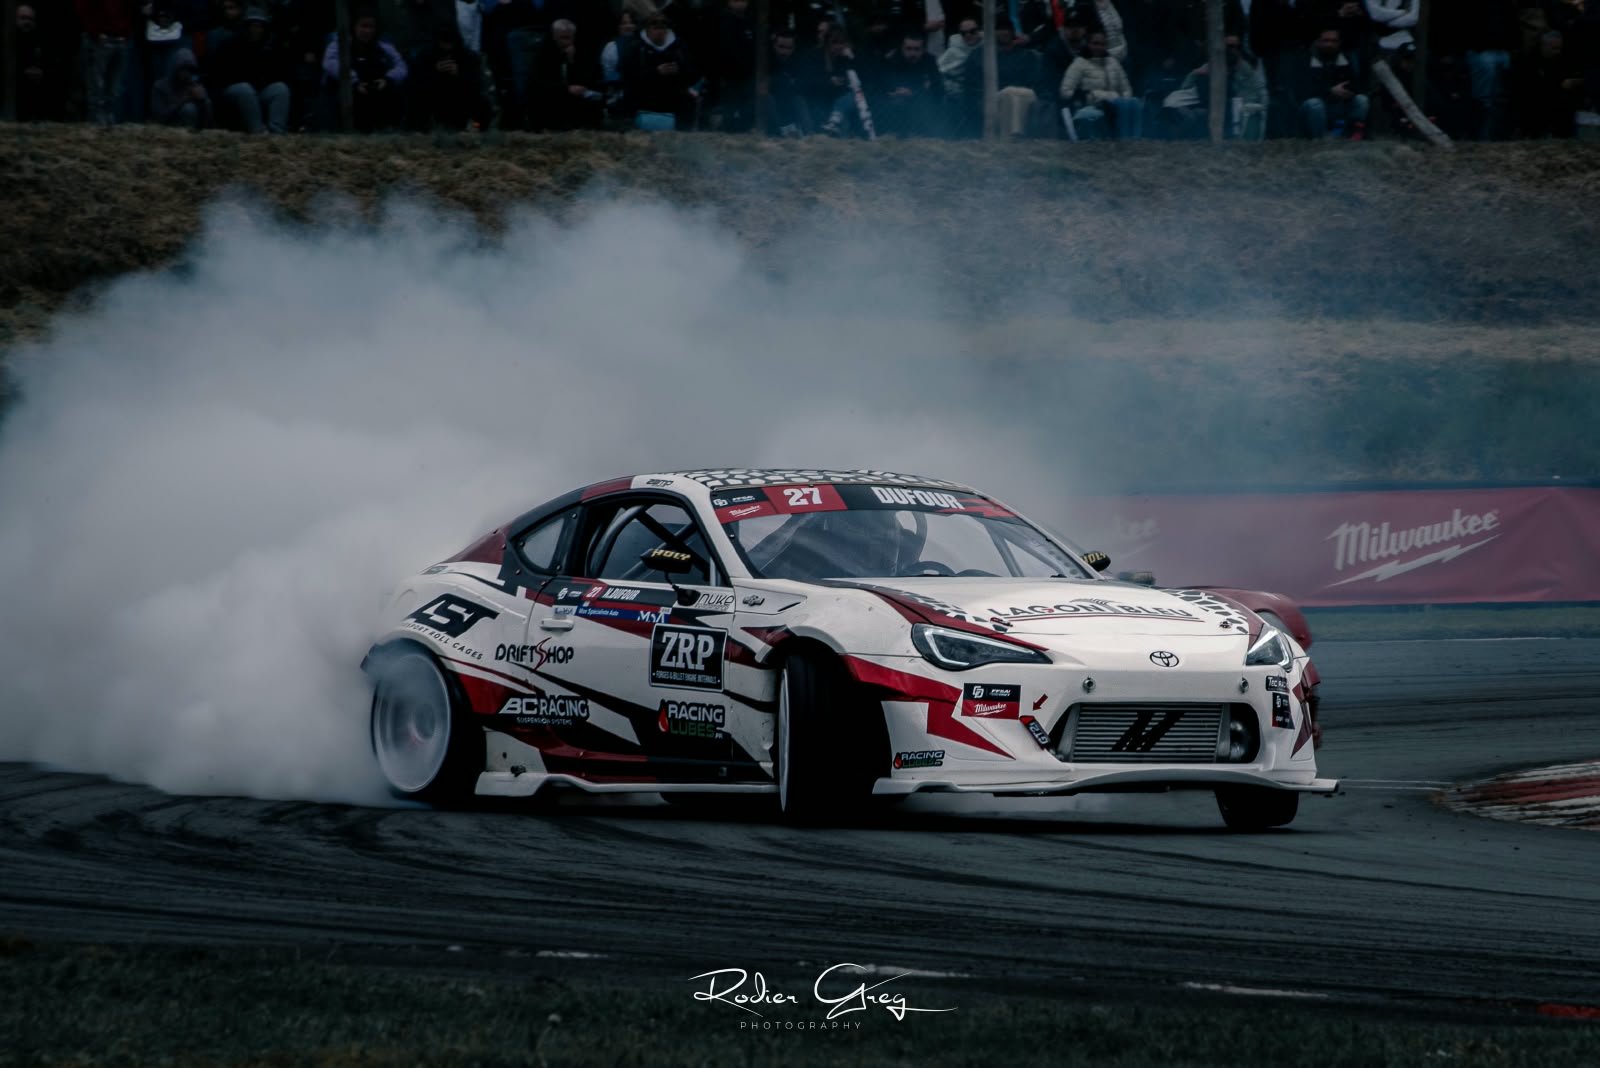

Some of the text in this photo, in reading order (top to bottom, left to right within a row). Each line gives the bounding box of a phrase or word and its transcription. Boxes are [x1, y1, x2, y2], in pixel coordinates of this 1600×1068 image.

[782, 487, 823, 506] 27
[870, 486, 965, 510] DUFOUR
[1325, 508, 1501, 571] Milwaukee
[650, 549, 692, 561] HOLY
[585, 586, 603, 598] 27
[987, 604, 1193, 617] LAGON BLEU
[428, 630, 450, 644] ROLL
[452, 642, 485, 660] CAGES
[660, 631, 715, 671] ZRP
[498, 697, 588, 718] BC RACING
[667, 703, 724, 724] RACING
[975, 703, 1007, 713] Milwaukee
[515, 716, 573, 726] SUSPENSION SYSTEMS
[670, 720, 715, 738] LUBES
[901, 751, 944, 761] RACING
